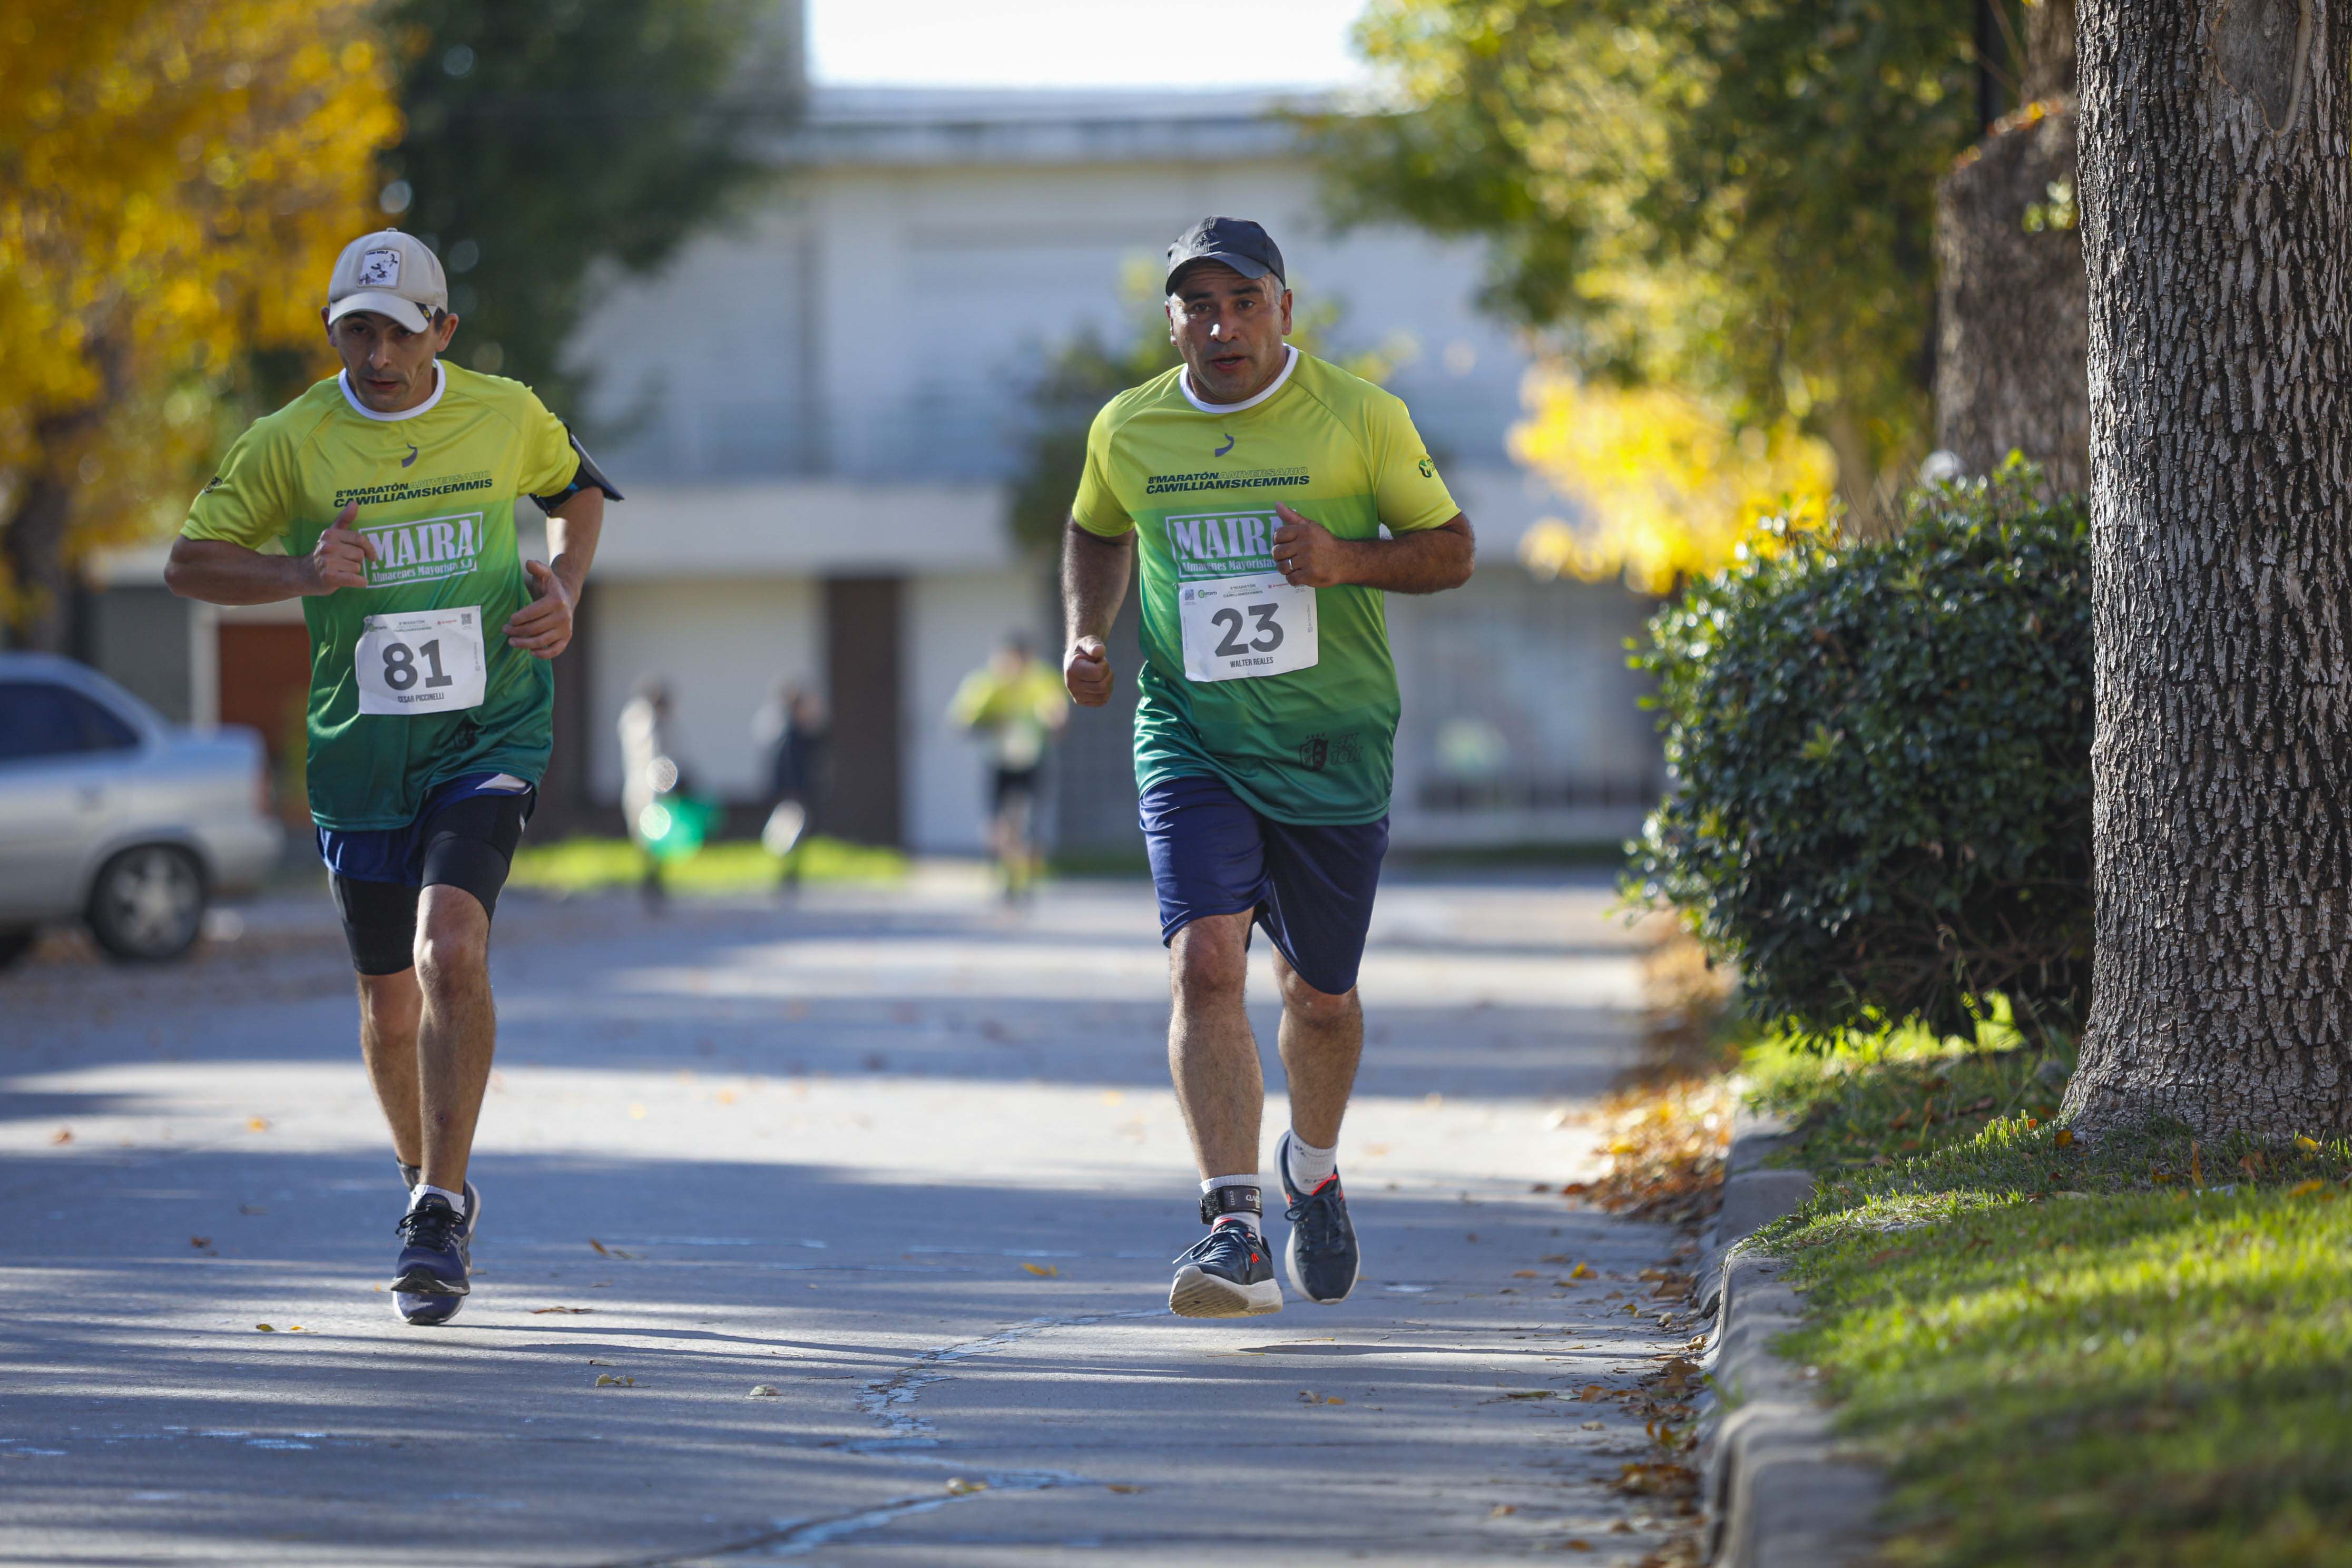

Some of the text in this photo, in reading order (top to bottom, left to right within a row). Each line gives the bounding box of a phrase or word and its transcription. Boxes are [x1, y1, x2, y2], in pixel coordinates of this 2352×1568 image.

[1146, 475, 1310, 494] CAWILLIAMSKEMMIS
[367, 520, 475, 570] MAIRA
[371, 568, 416, 583] Almacenes
[1211, 602, 1285, 657] 23
[383, 639, 453, 691] 81
[1230, 656, 1273, 668] WALTER REALES
